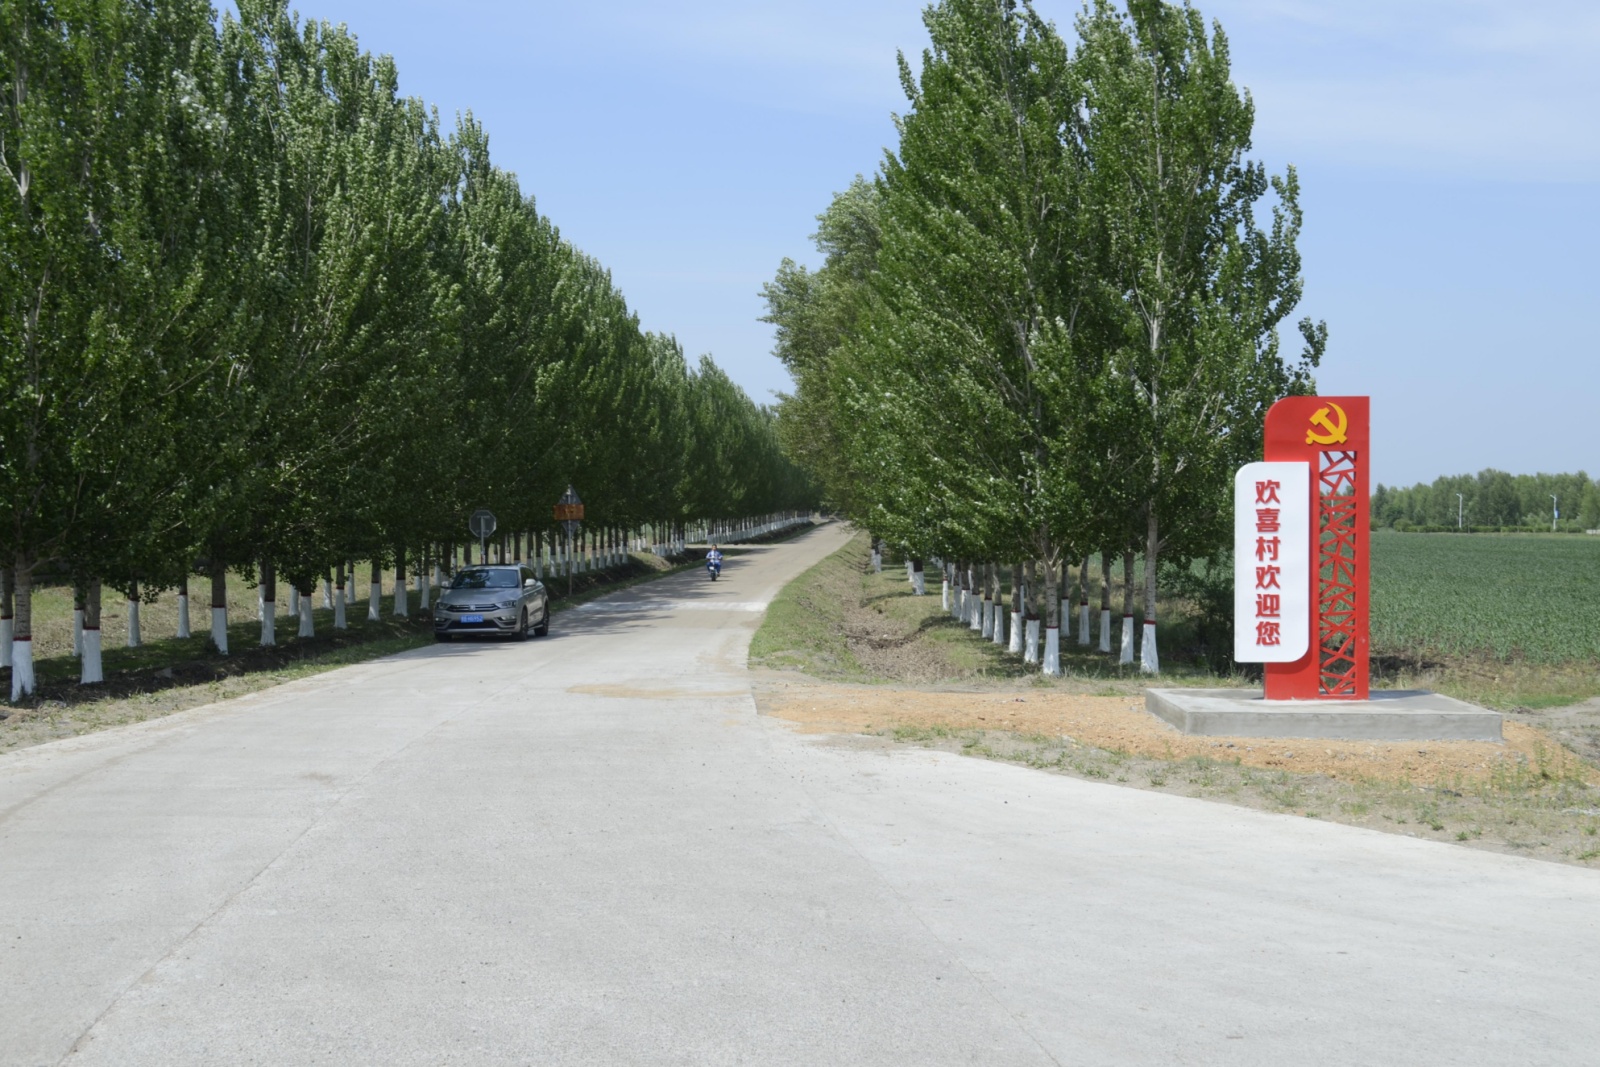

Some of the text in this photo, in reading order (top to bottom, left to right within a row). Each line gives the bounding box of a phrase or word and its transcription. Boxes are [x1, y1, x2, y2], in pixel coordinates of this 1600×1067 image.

[1255, 479, 1281, 646] 欢喜村欢迎您
